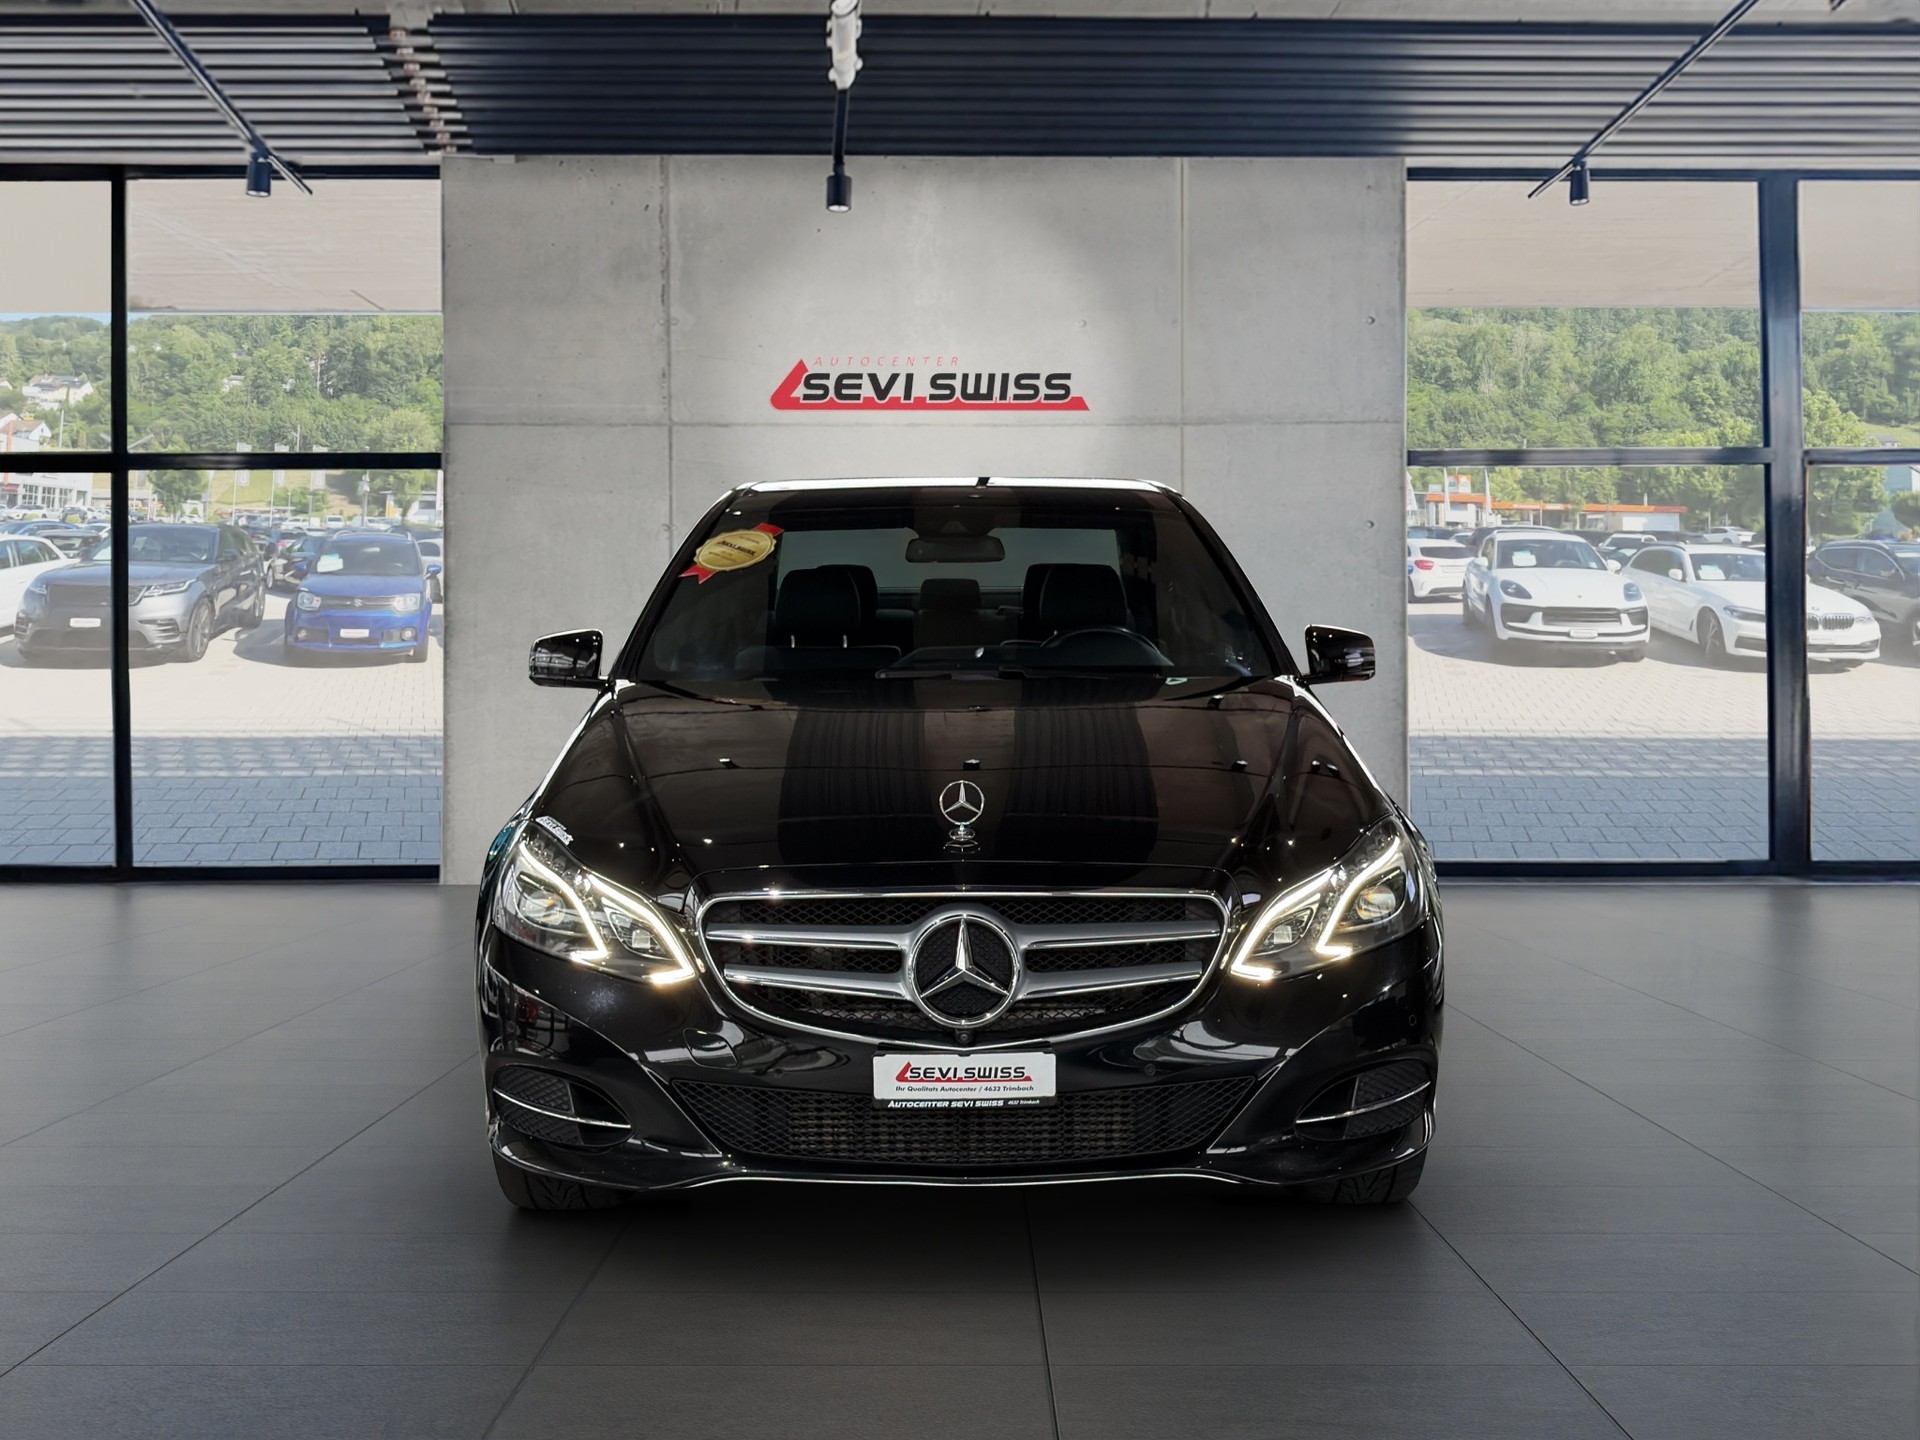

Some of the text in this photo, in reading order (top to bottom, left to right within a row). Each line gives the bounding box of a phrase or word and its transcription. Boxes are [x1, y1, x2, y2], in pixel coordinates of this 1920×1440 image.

[813, 355, 960, 367] AUTOCENTER
[801, 372, 1072, 402] SEVI SWISS
[908, 1066, 1026, 1079] SEVI SWISS
[950, 1100, 974, 1108] SEVI
[975, 1099, 1005, 1107] SWISS
